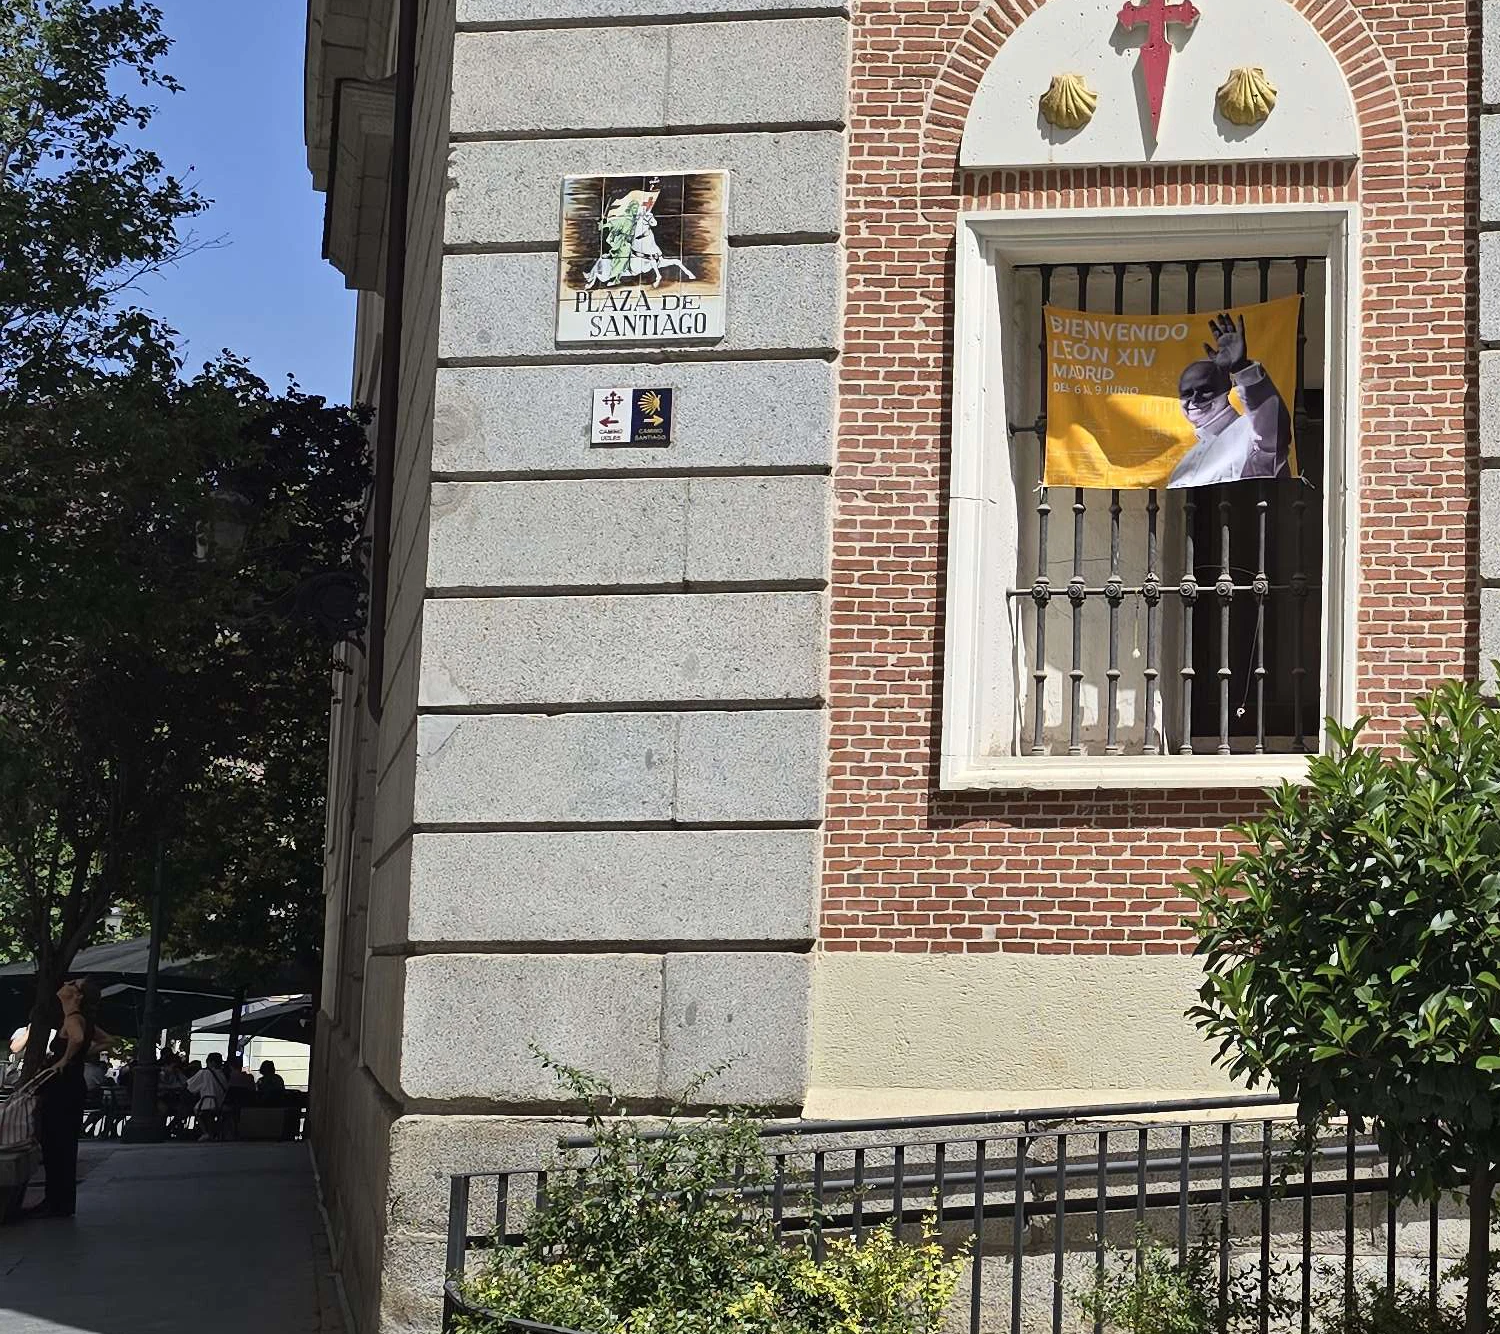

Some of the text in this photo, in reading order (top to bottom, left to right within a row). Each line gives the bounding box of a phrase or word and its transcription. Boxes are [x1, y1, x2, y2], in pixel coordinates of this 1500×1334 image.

[574, 289, 701, 313] PLAZA DE
[589, 312, 707, 337] SANTIAGO
[1050, 315, 1189, 342] BIENVENIDO
[1053, 339, 1156, 367] LEÓN XIV
[1053, 363, 1115, 383] MADRID
[1053, 382, 1071, 393] DEL
[1074, 385, 1081, 395] 6
[1105, 385, 1139, 395] JUNIO
